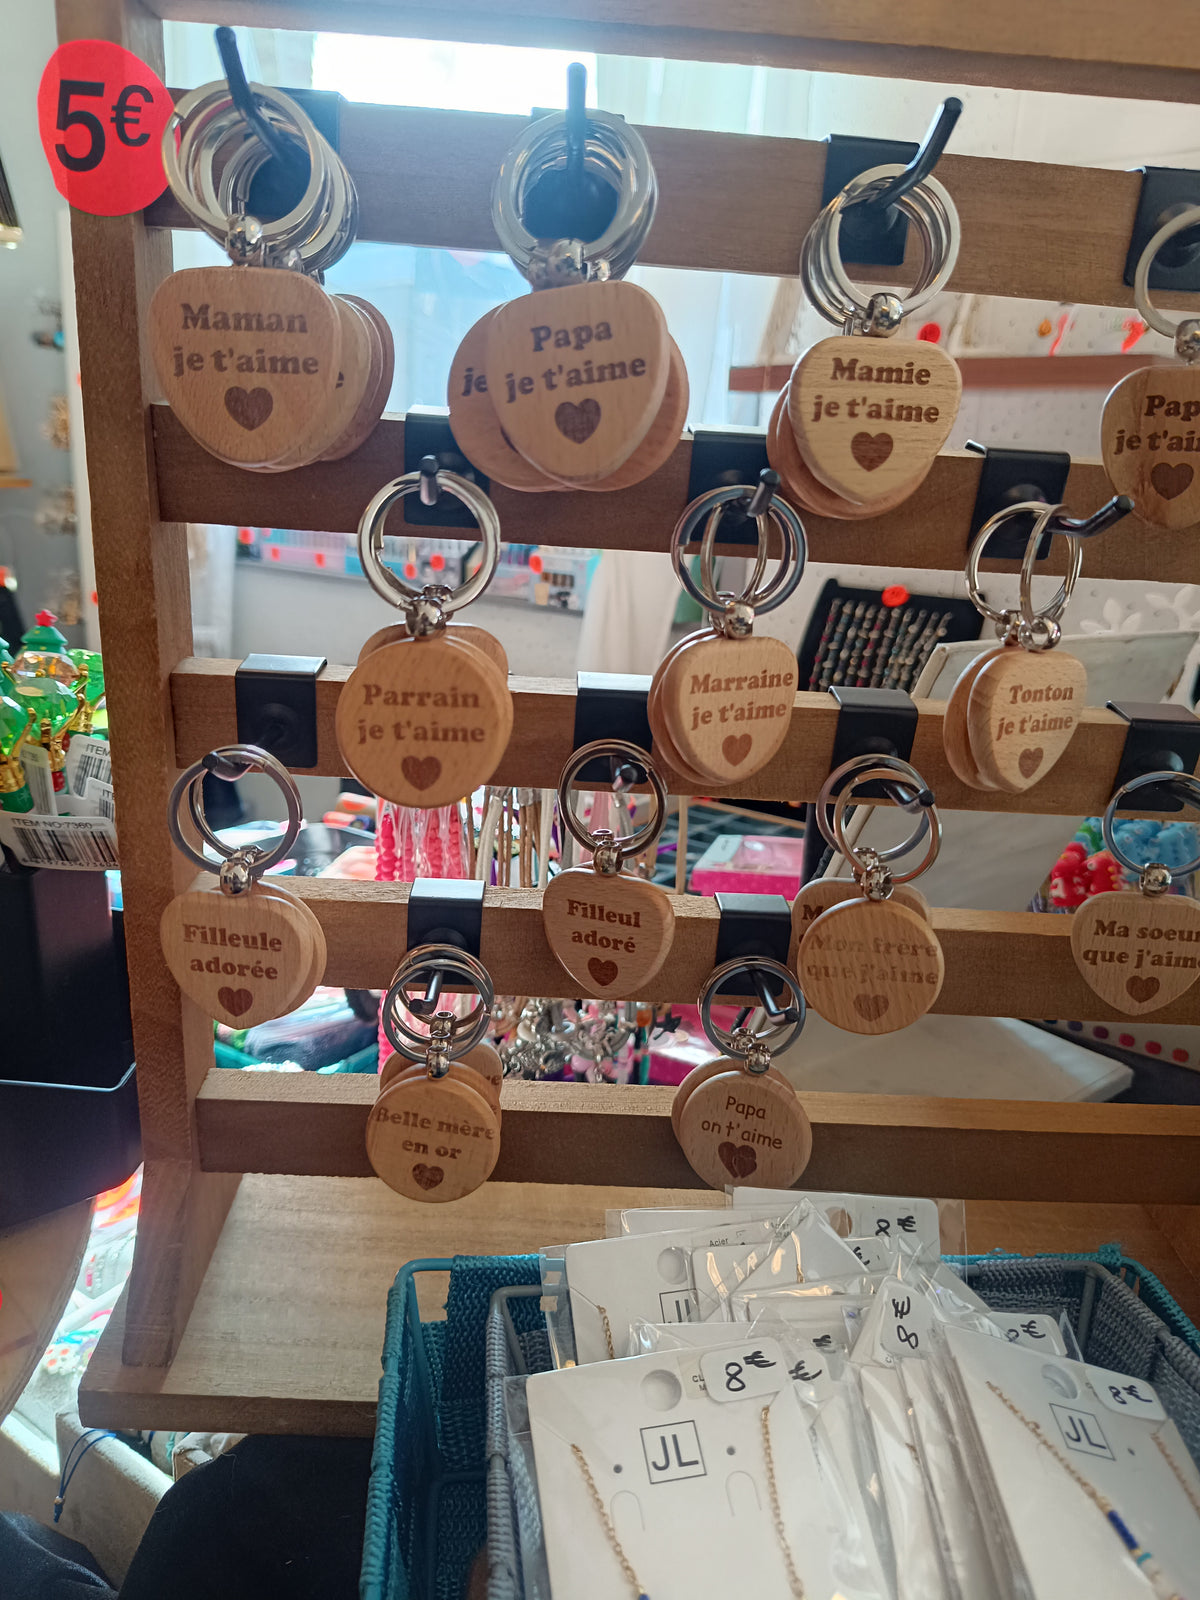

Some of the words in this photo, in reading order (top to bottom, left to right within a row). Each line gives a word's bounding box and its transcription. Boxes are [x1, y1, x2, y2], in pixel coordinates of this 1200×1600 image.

[54, 79, 154, 172] 5€
[180, 303, 308, 334] Maman
[530, 321, 613, 352] Papa
[173, 347, 204, 376] je
[210, 347, 319, 376] t'aime
[830, 358, 931, 385] Mamie
[505, 373, 534, 403] je
[542, 357, 646, 391] t'aime
[811, 395, 839, 423] je
[846, 397, 940, 423] t'aime
[1113, 429, 1141, 455] je
[1146, 430, 1200, 452] t'ai
[690, 669, 794, 694] Marraine
[1009, 684, 1073, 704] Tonton
[362, 684, 480, 708] Parrain
[691, 706, 712, 731] je
[719, 702, 787, 723] t'aime
[996, 716, 1015, 741] je
[1019, 713, 1073, 734] t'aime
[358, 719, 384, 744] je
[393, 720, 485, 743] t'aime
[567, 899, 641, 928] Filleul
[183, 923, 282, 952] Filleule
[571, 930, 636, 953] adoré
[1094, 919, 1129, 938] Ma
[873, 936, 938, 957] frère
[1083, 949, 1129, 966] que
[1134, 949, 1200, 969] j'aim
[190, 957, 278, 980] adorée
[807, 964, 857, 981] que
[726, 1095, 766, 1120] Papa
[376, 1106, 431, 1129] Belle
[437, 1120, 495, 1140] mère
[702, 1120, 722, 1134] on
[402, 1139, 428, 1155] en
[435, 1145, 462, 1160] or
[1065, 1416, 1107, 1449] JL
[651, 1434, 699, 1470] JL
